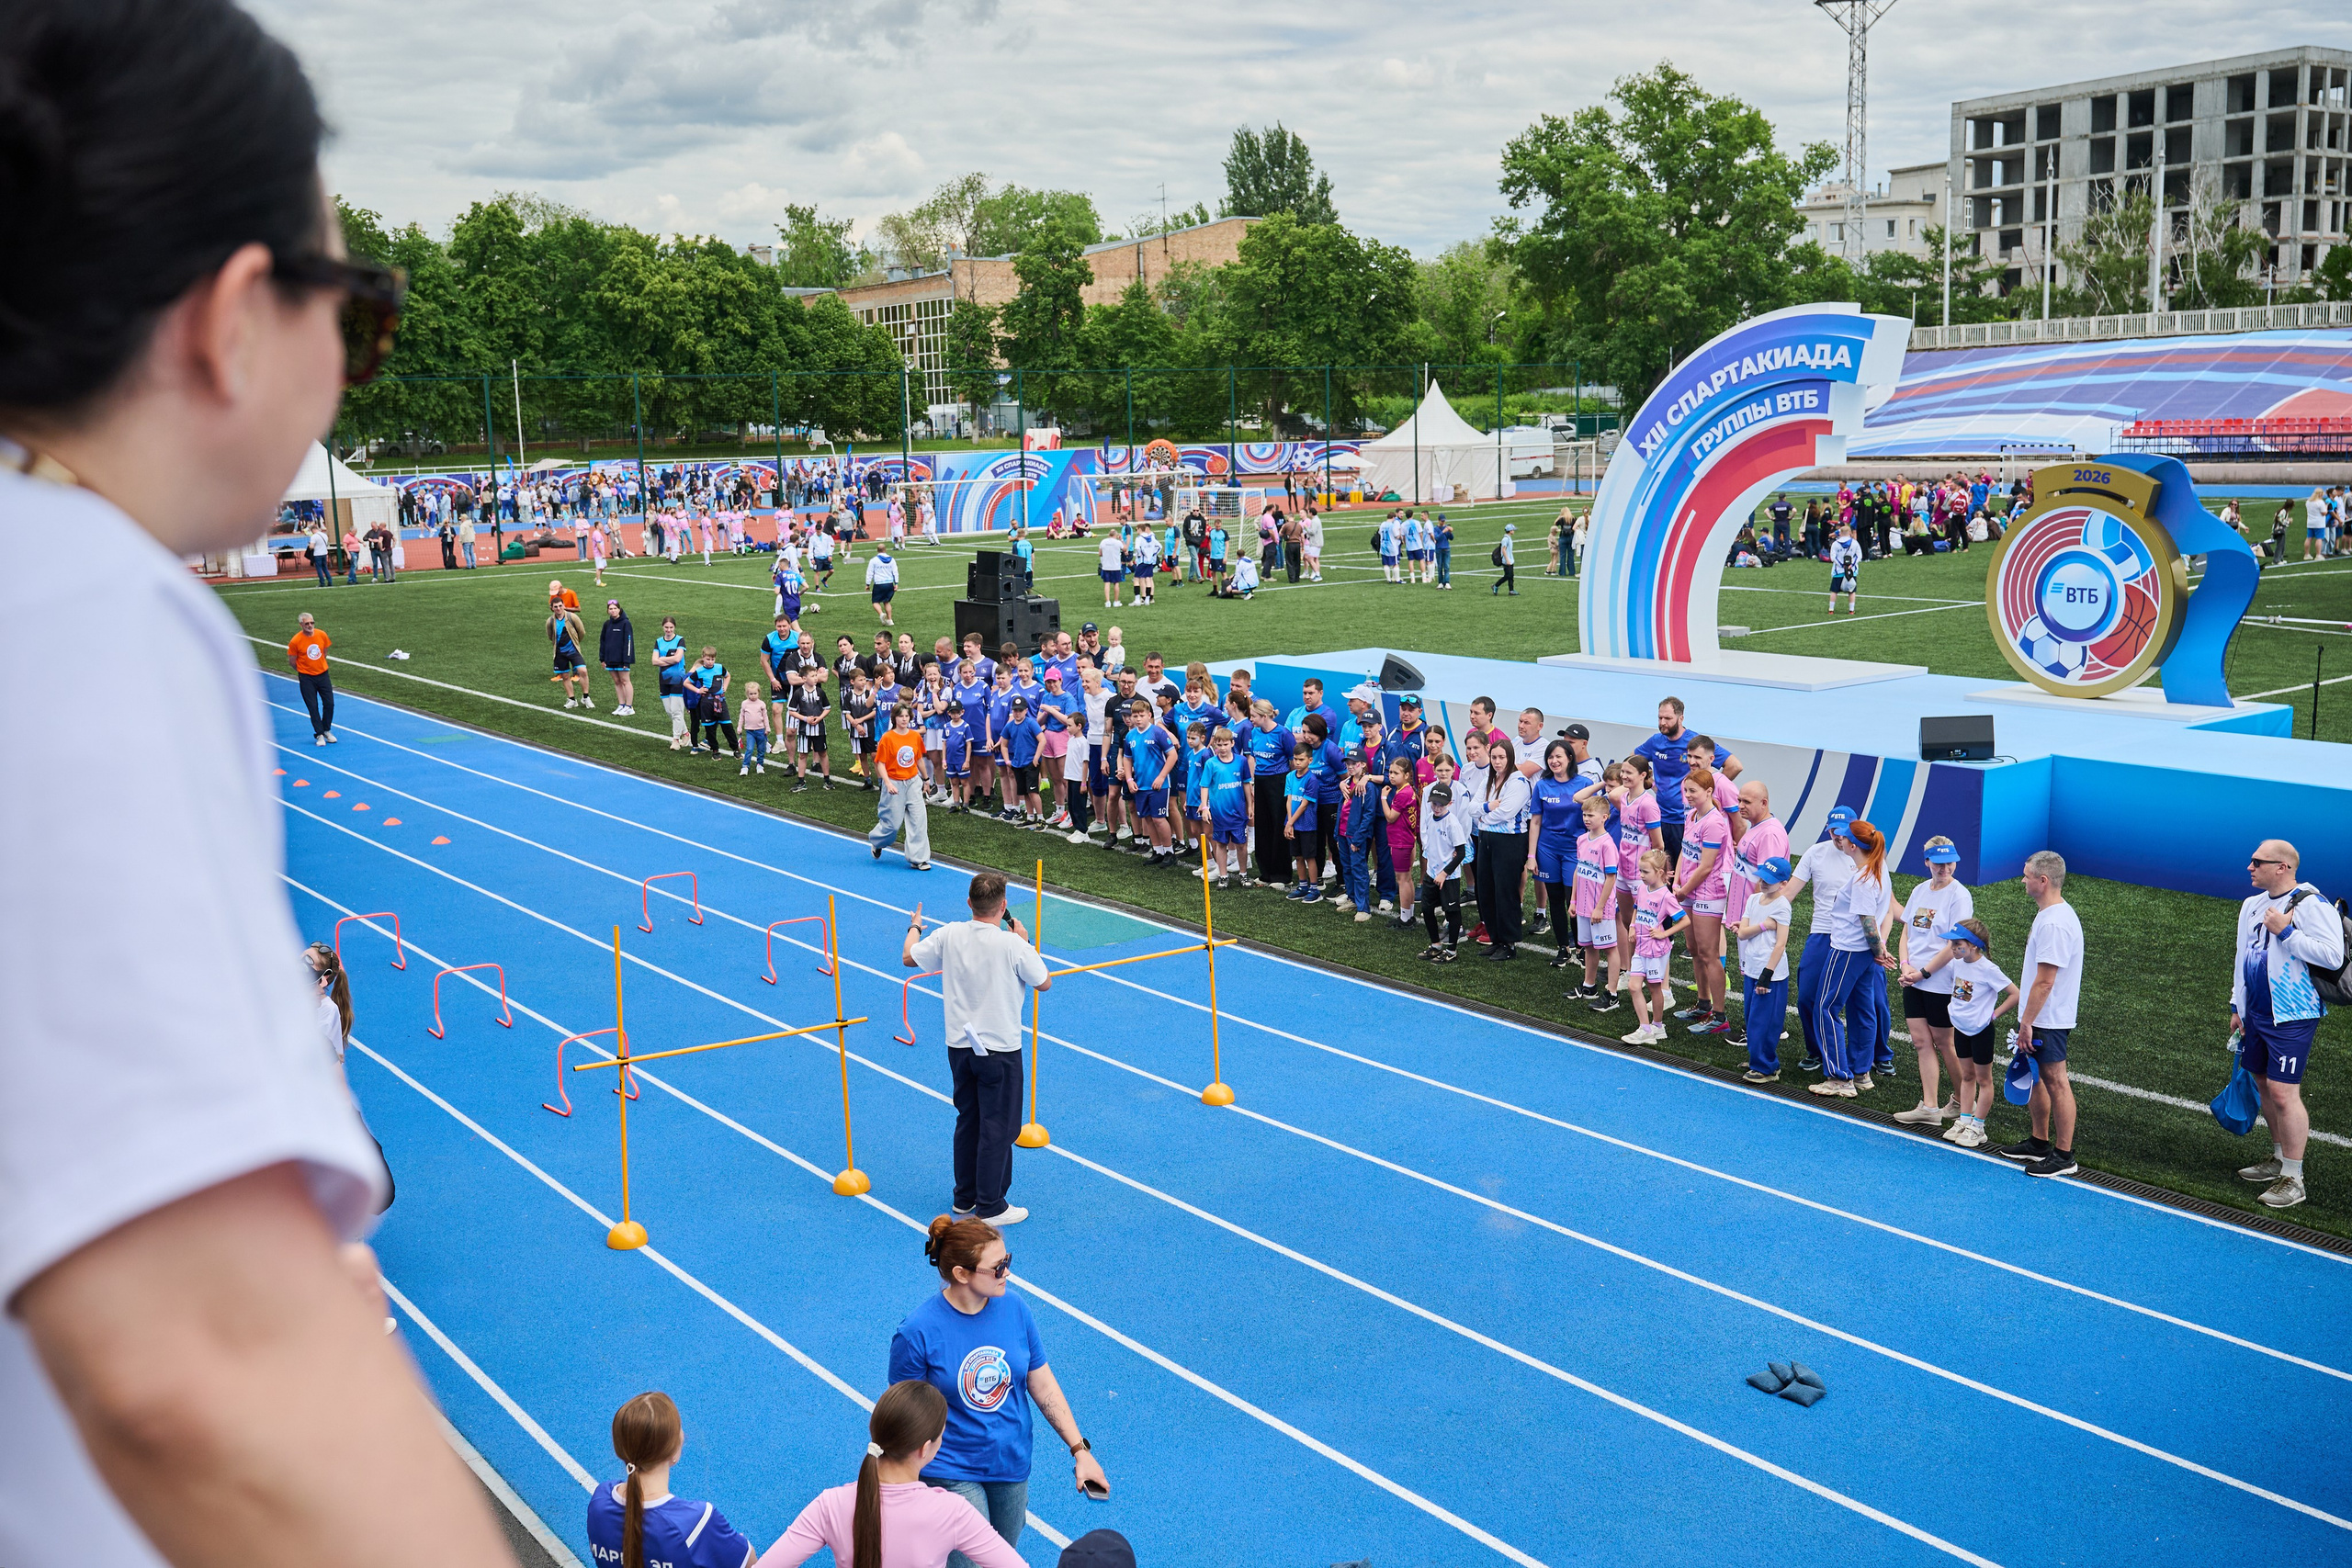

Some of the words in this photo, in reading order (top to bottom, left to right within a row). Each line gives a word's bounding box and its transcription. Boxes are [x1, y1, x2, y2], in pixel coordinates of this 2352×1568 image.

[1638, 423, 1668, 460] XII
[1666, 344, 1852, 426] СПАРТАКИАДА
[1690, 398, 1773, 460] ГРУППЫ
[1776, 389, 1819, 413] ВТБ
[1003, 459, 1048, 472] СПАРАКИАДА
[2073, 468, 2111, 484] 2026
[785, 580, 798, 595] 10
[2066, 587, 2098, 604] ВТБ
[1035, 666, 1043, 674] 11
[881, 702, 895, 711] ВТ
[1179, 715, 1189, 723] 10
[1766, 863, 1778, 873] ВТБ
[1636, 915, 1655, 924] МАР
[1600, 934, 1612, 942] ВТБ
[2278, 1055, 2298, 1075] 11
[984, 1375, 997, 1383] ВТБ
